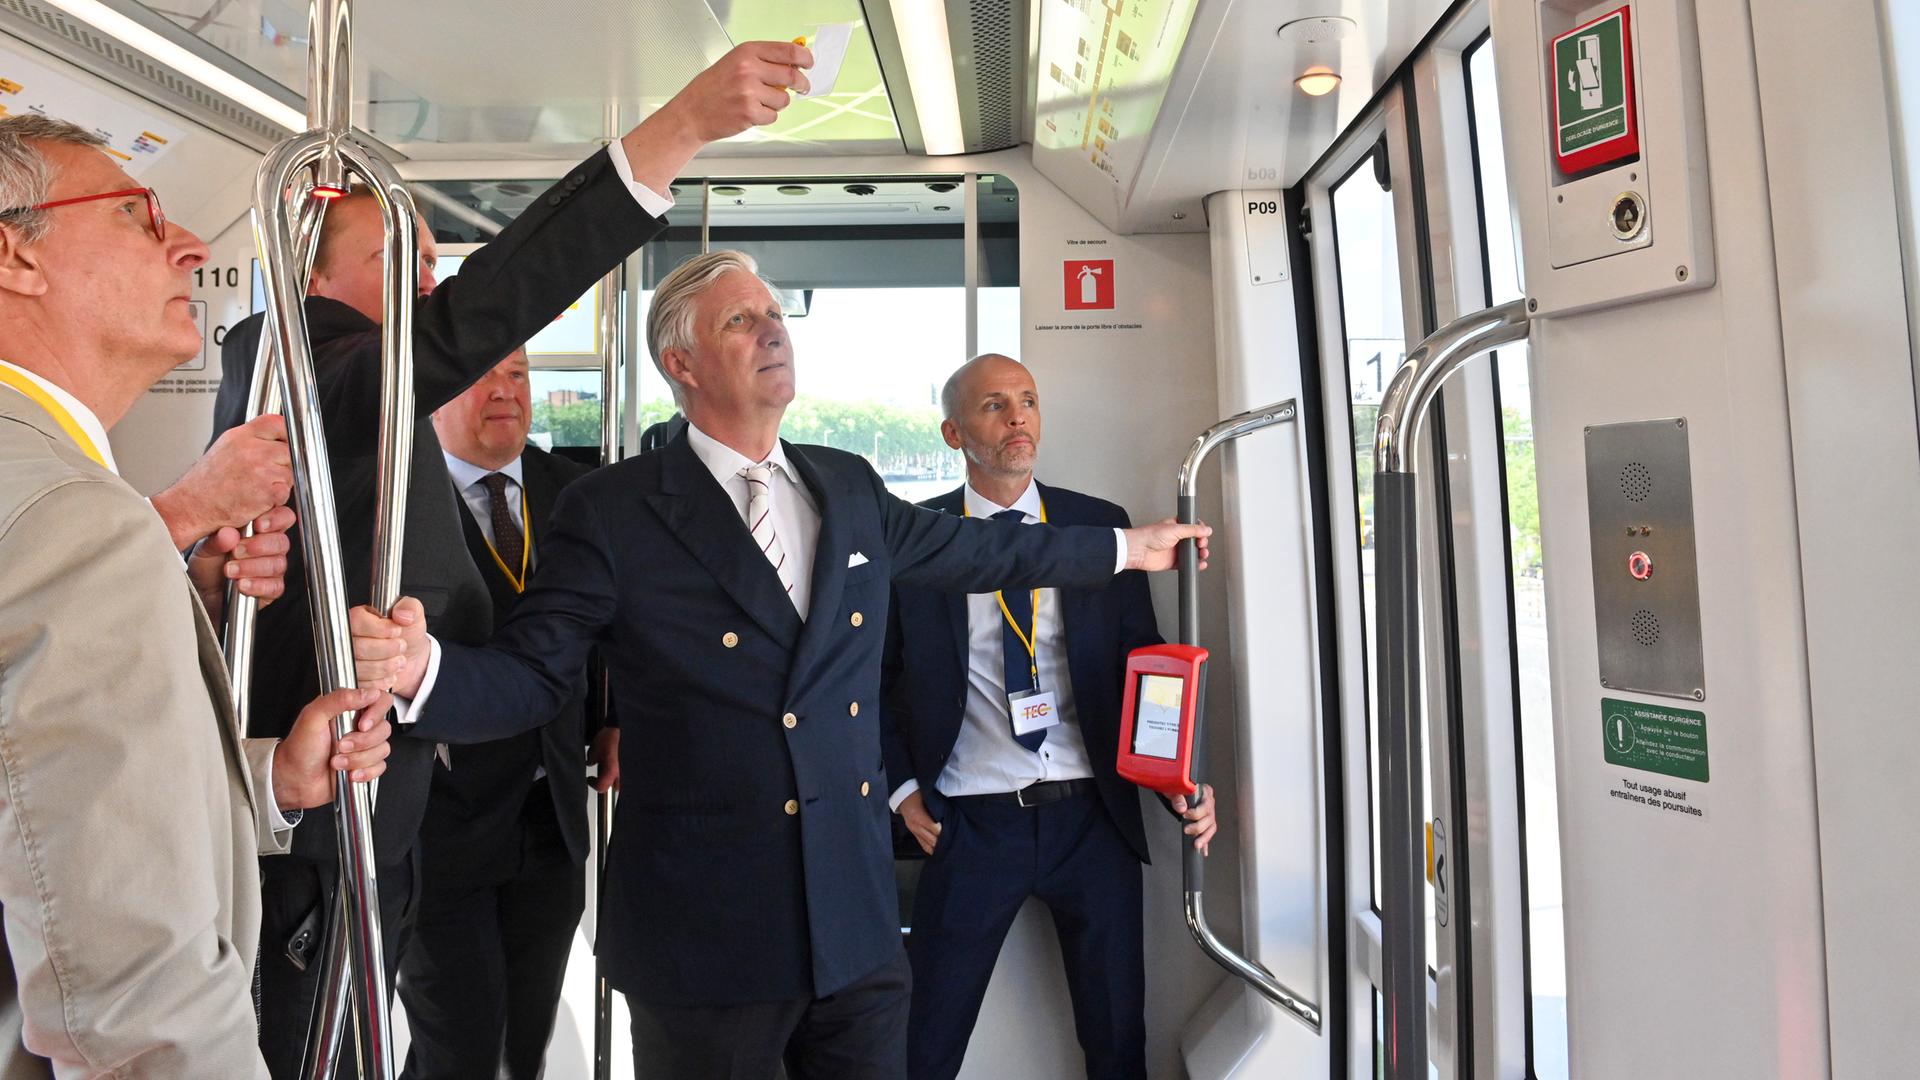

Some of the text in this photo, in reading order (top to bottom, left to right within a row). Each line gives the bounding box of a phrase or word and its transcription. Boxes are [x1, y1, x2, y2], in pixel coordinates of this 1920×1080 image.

[1248, 202, 1277, 214] P09
[1023, 702, 1048, 720] TEC
[1635, 710, 1667, 721] ASSISTANCE
[1680, 731, 1699, 740] bouton
[1623, 779, 1686, 801] Tout usage abusif
[1647, 797, 1661, 807] des
[1663, 800, 1703, 817] poursuites
